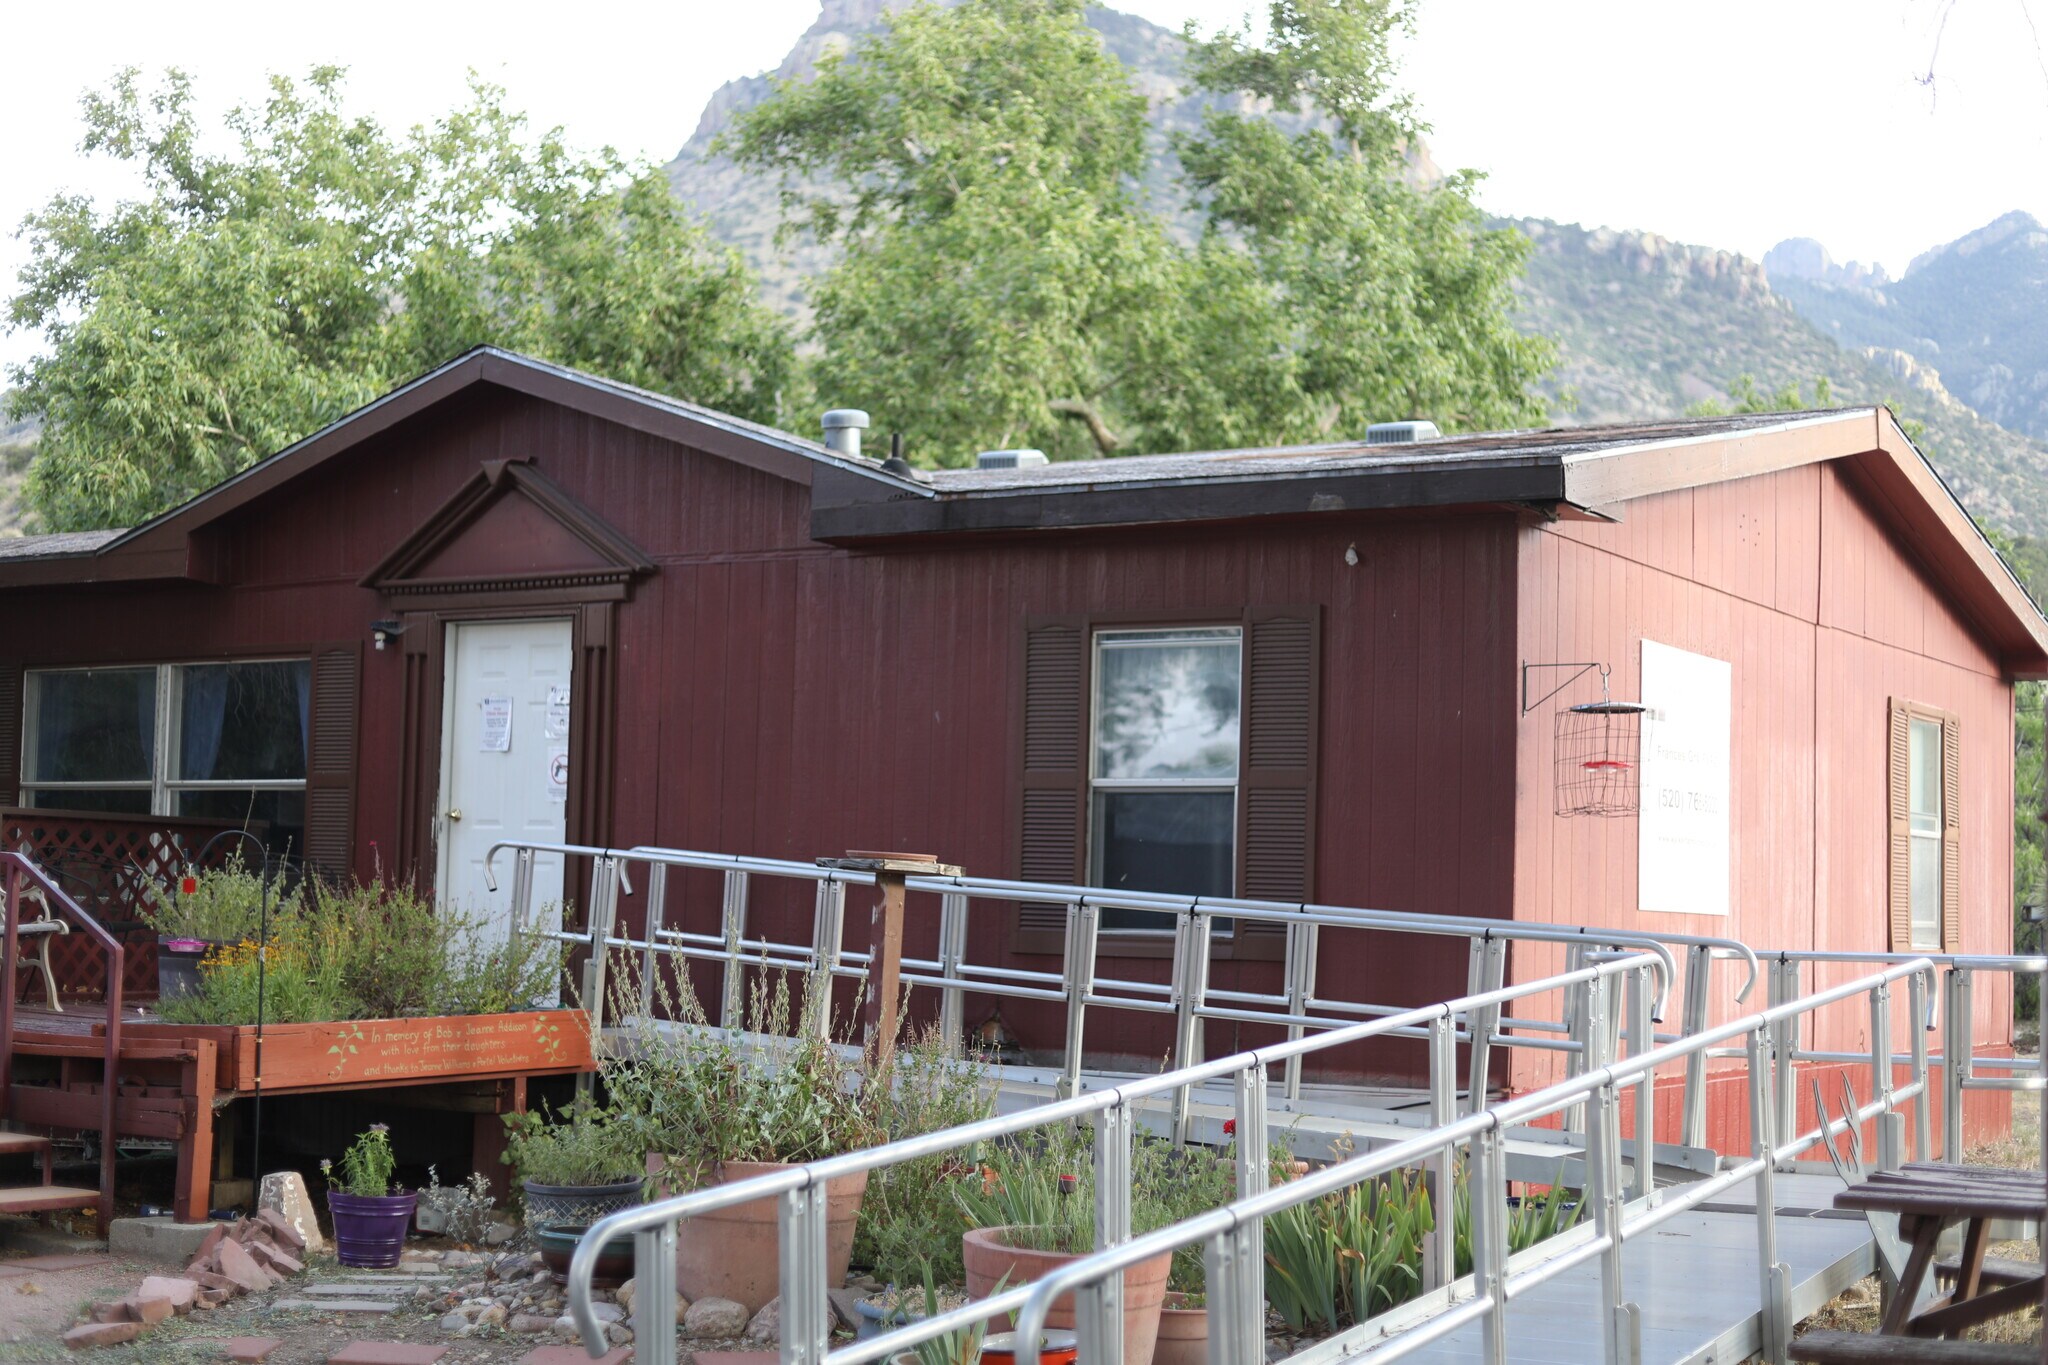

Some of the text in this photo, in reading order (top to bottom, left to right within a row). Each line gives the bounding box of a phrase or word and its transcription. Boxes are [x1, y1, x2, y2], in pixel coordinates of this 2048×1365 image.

[1657, 785, 1684, 815] (520)
[371, 1026, 381, 1043] In
[385, 1032, 420, 1045] memory
[423, 1028, 433, 1044] of
[436, 1025, 453, 1038] Bob
[465, 1022, 495, 1036] Jeanne
[498, 1020, 528, 1033] Addison
[381, 1039, 506, 1056] with love from their daughters
[364, 1064, 381, 1076] and
[384, 1062, 409, 1074] thanks
[411, 1063, 418, 1073] to
[497, 1053, 530, 1065] Volunteers
